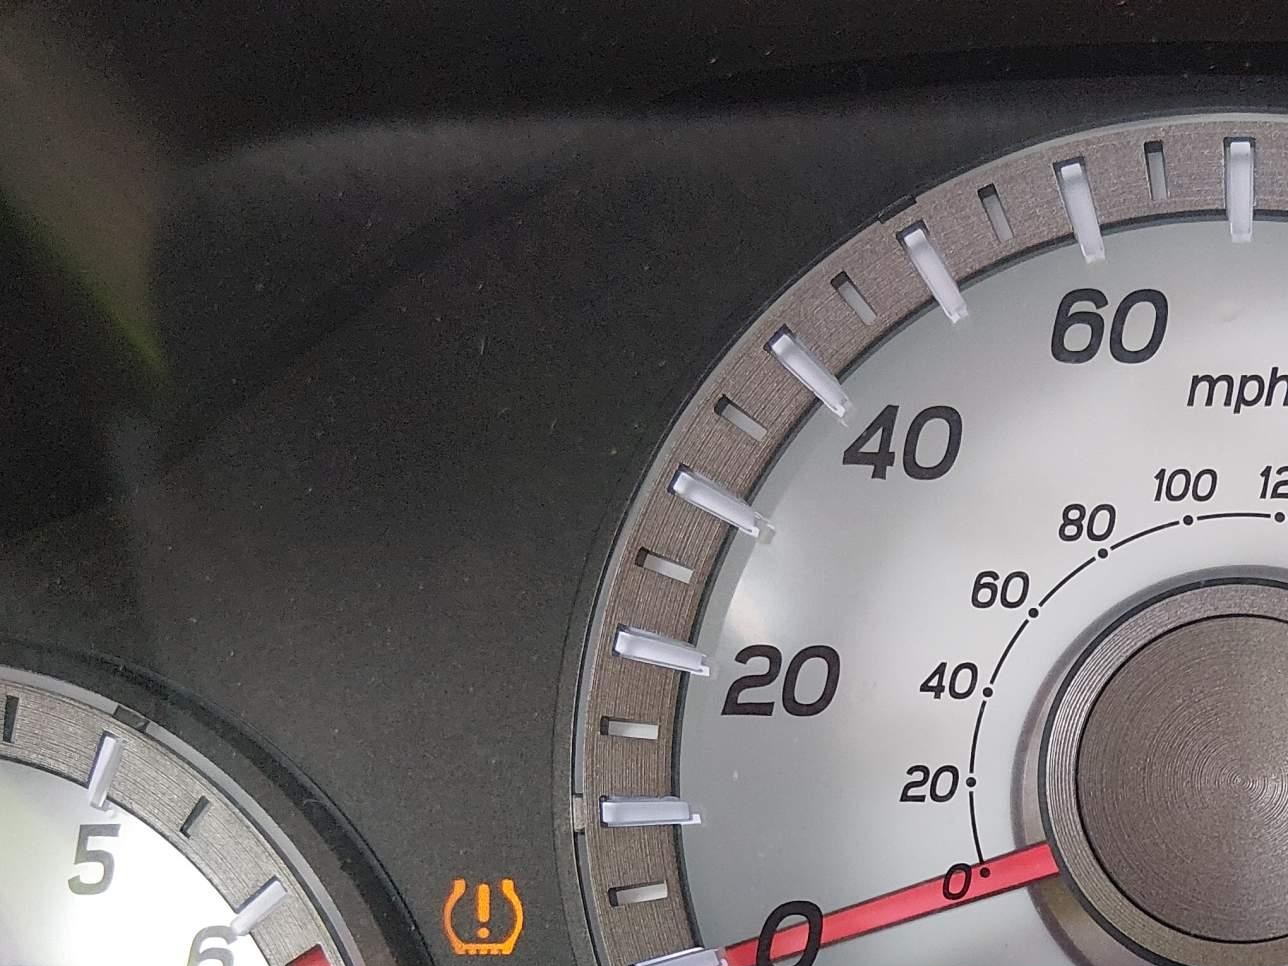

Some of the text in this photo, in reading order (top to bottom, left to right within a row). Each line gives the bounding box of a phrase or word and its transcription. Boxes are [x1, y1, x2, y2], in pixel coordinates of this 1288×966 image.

[1051, 288, 1168, 363] 60
[843, 405, 962, 480] 40
[1154, 469, 1217, 501] 100
[1059, 504, 1116, 541] 80
[972, 571, 1029, 608] 60
[721, 645, 840, 716] 20
[920, 662, 978, 699] 40
[900, 765, 959, 802] 20
[68, 824, 120, 895] 5
[943, 863, 972, 899] 0
